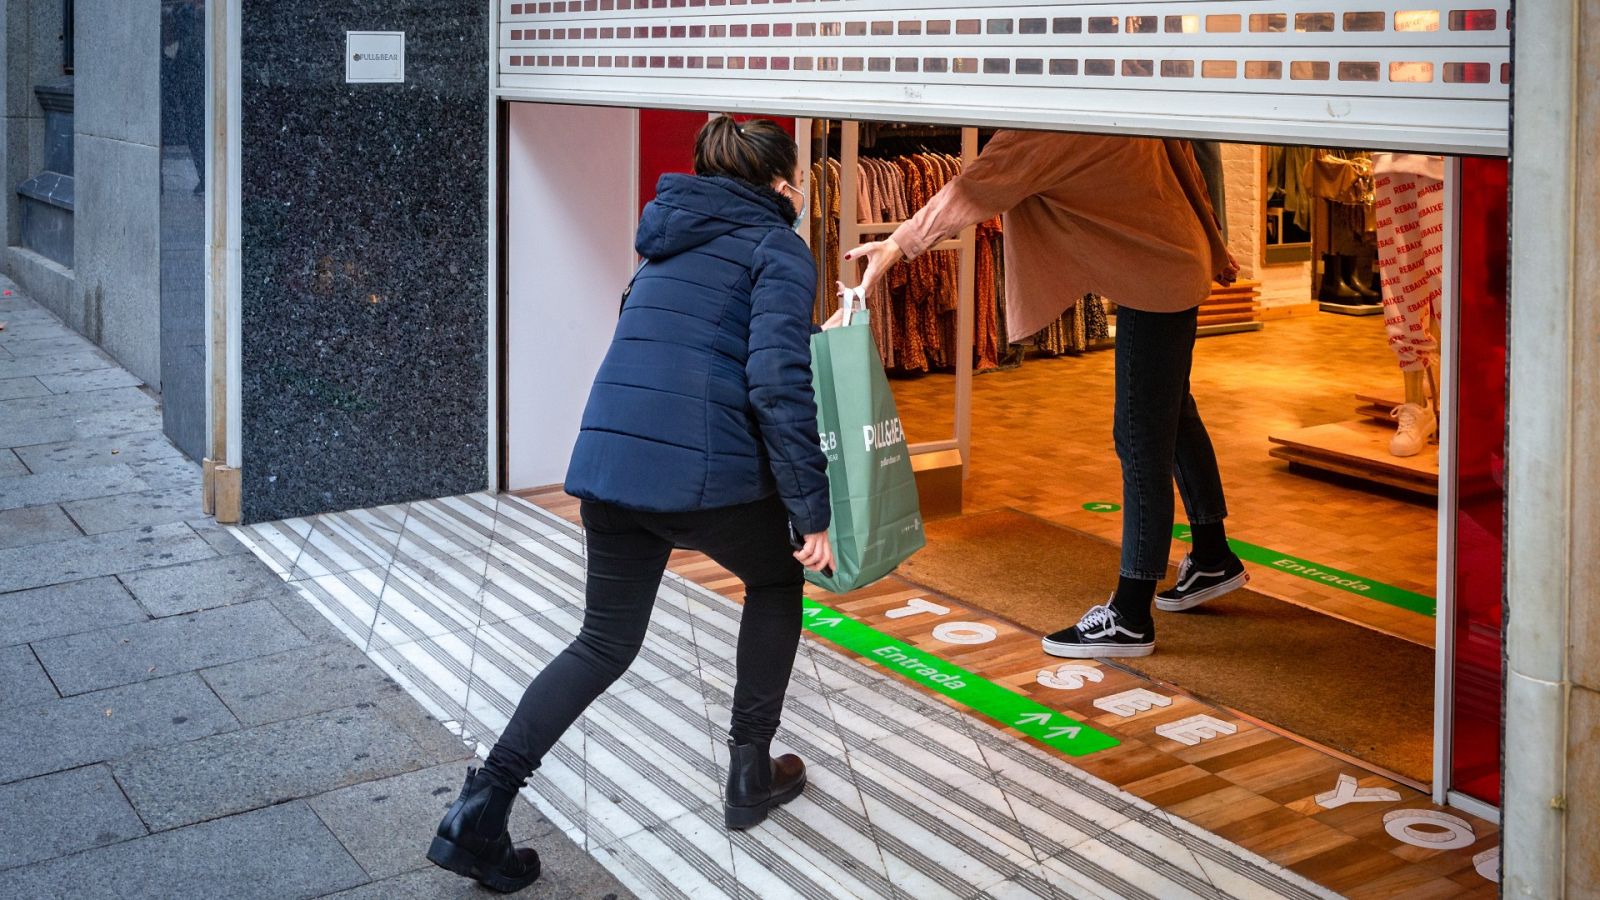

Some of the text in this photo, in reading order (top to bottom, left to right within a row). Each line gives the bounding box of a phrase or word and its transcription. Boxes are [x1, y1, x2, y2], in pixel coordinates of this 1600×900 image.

[1395, 220, 1420, 235] REBAIX
[1396, 240, 1422, 255] REBAIX
[819, 431, 838, 452] &B
[863, 417, 906, 452] PULL&BEA
[1271, 558, 1371, 592] Entrada
[871, 645, 967, 690] Entrada
[885, 598, 998, 645] TO
[1036, 664, 1238, 746] SEE
